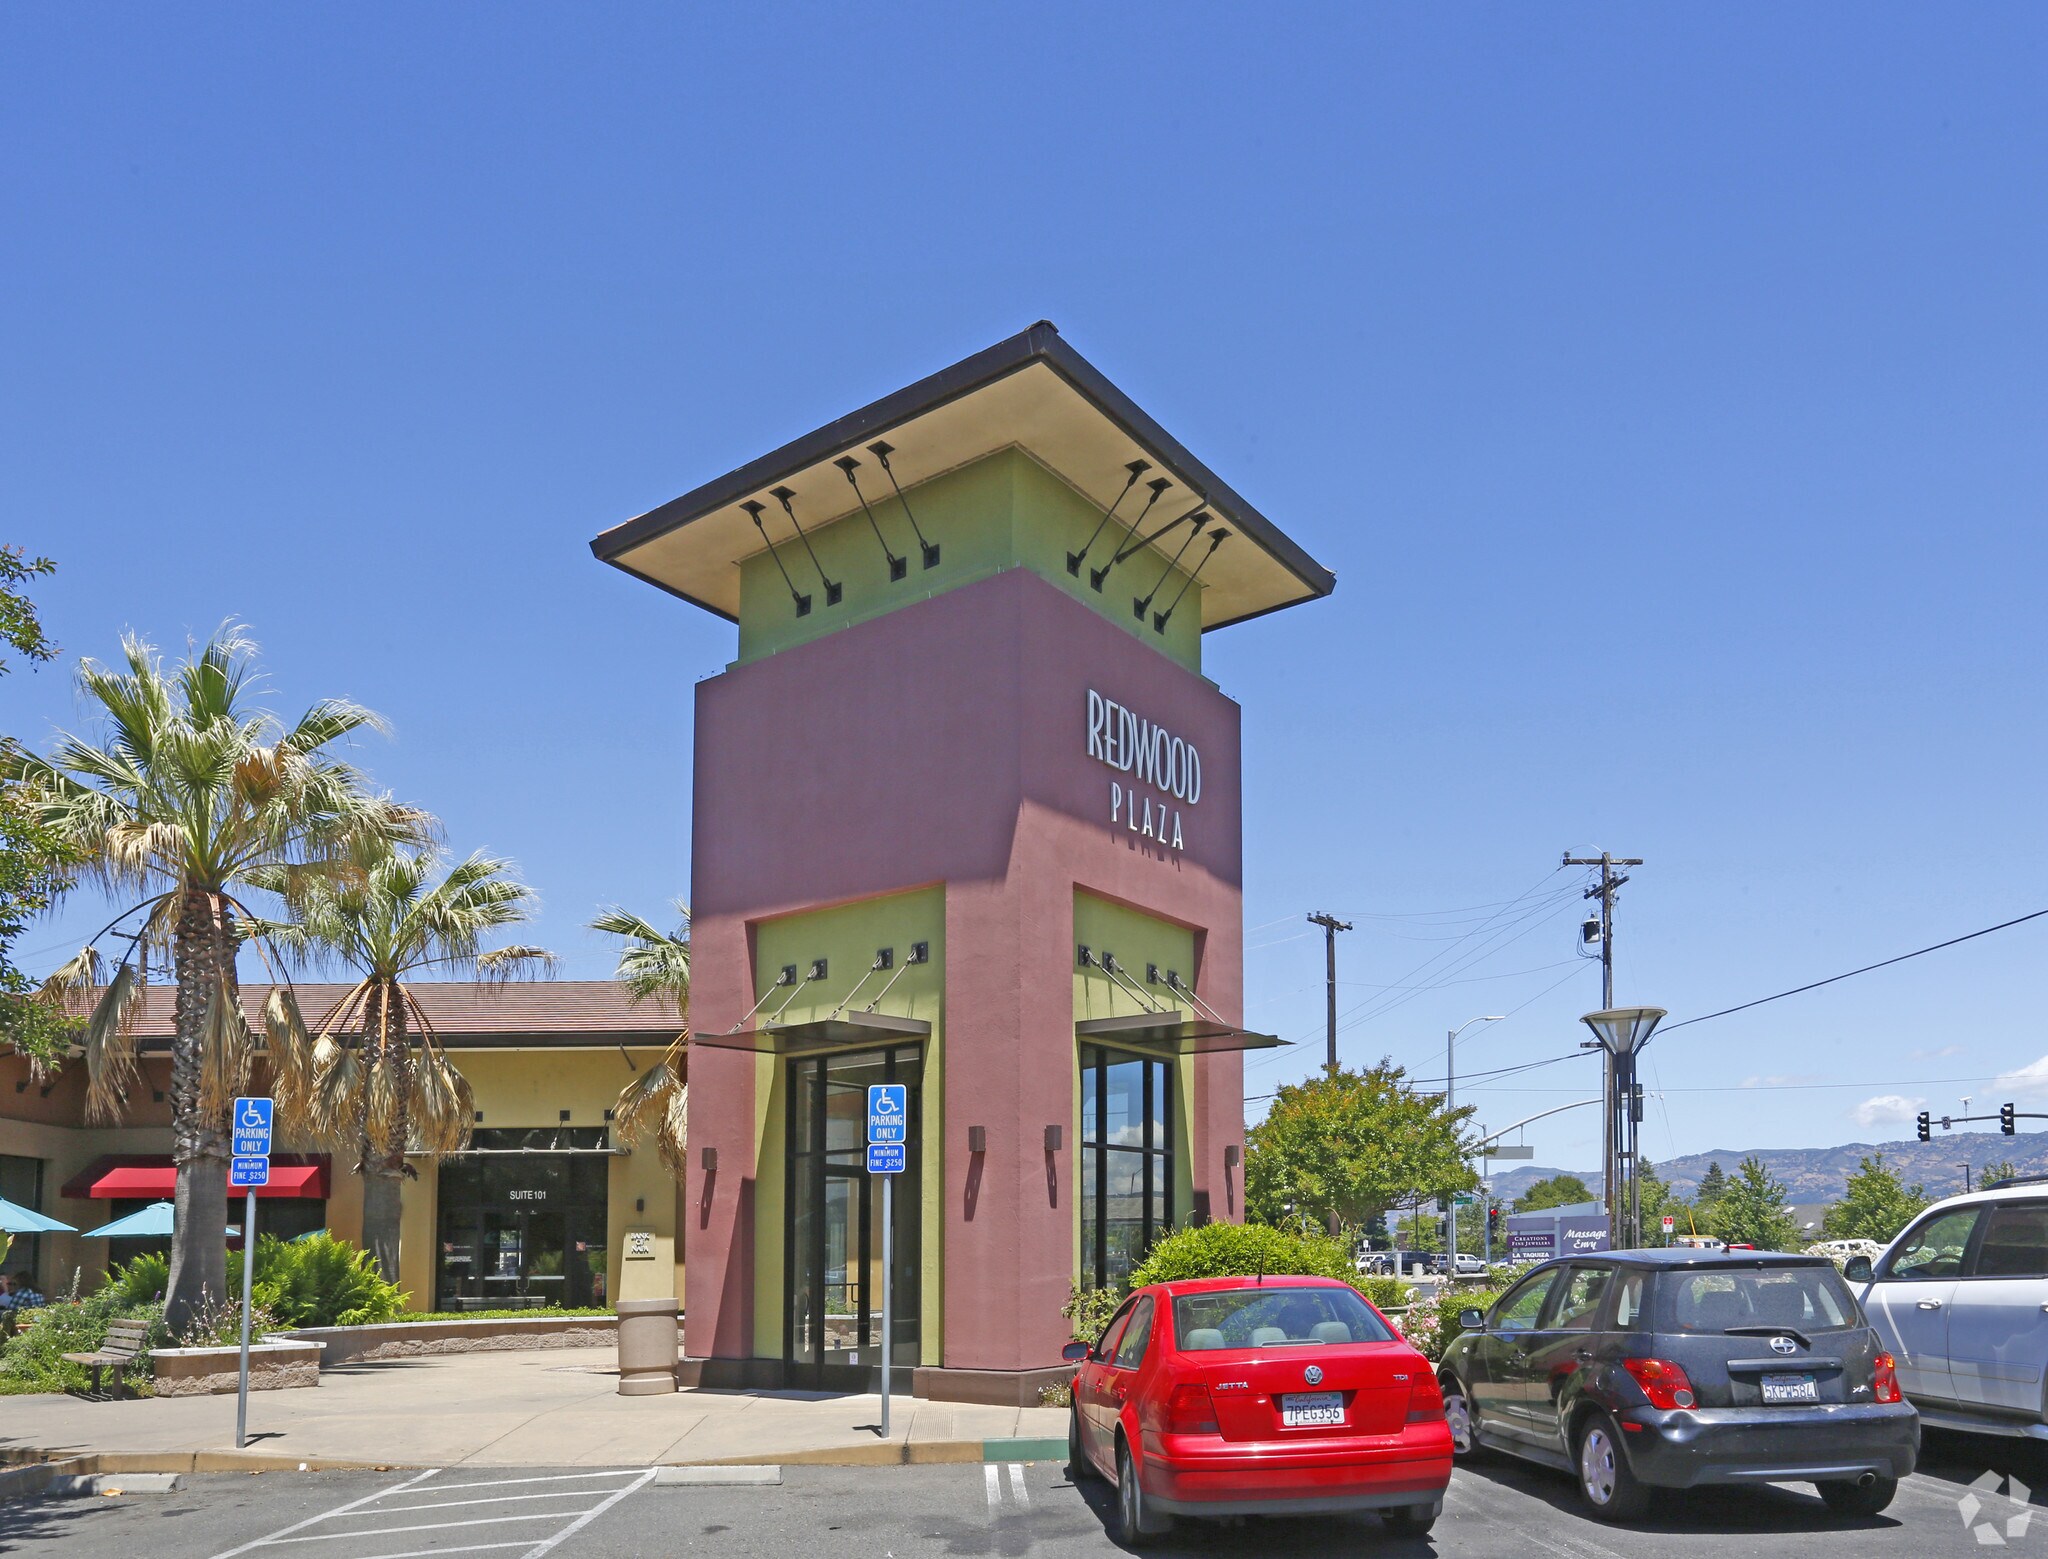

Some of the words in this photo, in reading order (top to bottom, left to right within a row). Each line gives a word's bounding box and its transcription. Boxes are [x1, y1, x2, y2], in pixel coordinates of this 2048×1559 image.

[1087, 689, 1200, 805] REDWOOD
[1110, 782, 1184, 850] PLAZA
[870, 1115, 903, 1126] PARKING
[235, 1127, 269, 1139] PARKING
[876, 1128, 897, 1139] ONLY
[240, 1140, 262, 1152] ONLY
[873, 1149, 899, 1157] MINIMUM
[870, 1159, 883, 1167] FINE
[886, 1159, 902, 1167] $250
[233, 1171, 247, 1180] FINE
[249, 1171, 266, 1180] $250
[509, 1190, 533, 1200] SUITE
[534, 1190, 546, 1199] 101
[1563, 1229, 1607, 1240] Massage
[1573, 1239, 1597, 1250] Envy
[1215, 1381, 1249, 1390] JETTA
[1286, 1403, 1340, 1421] 7PEG356
